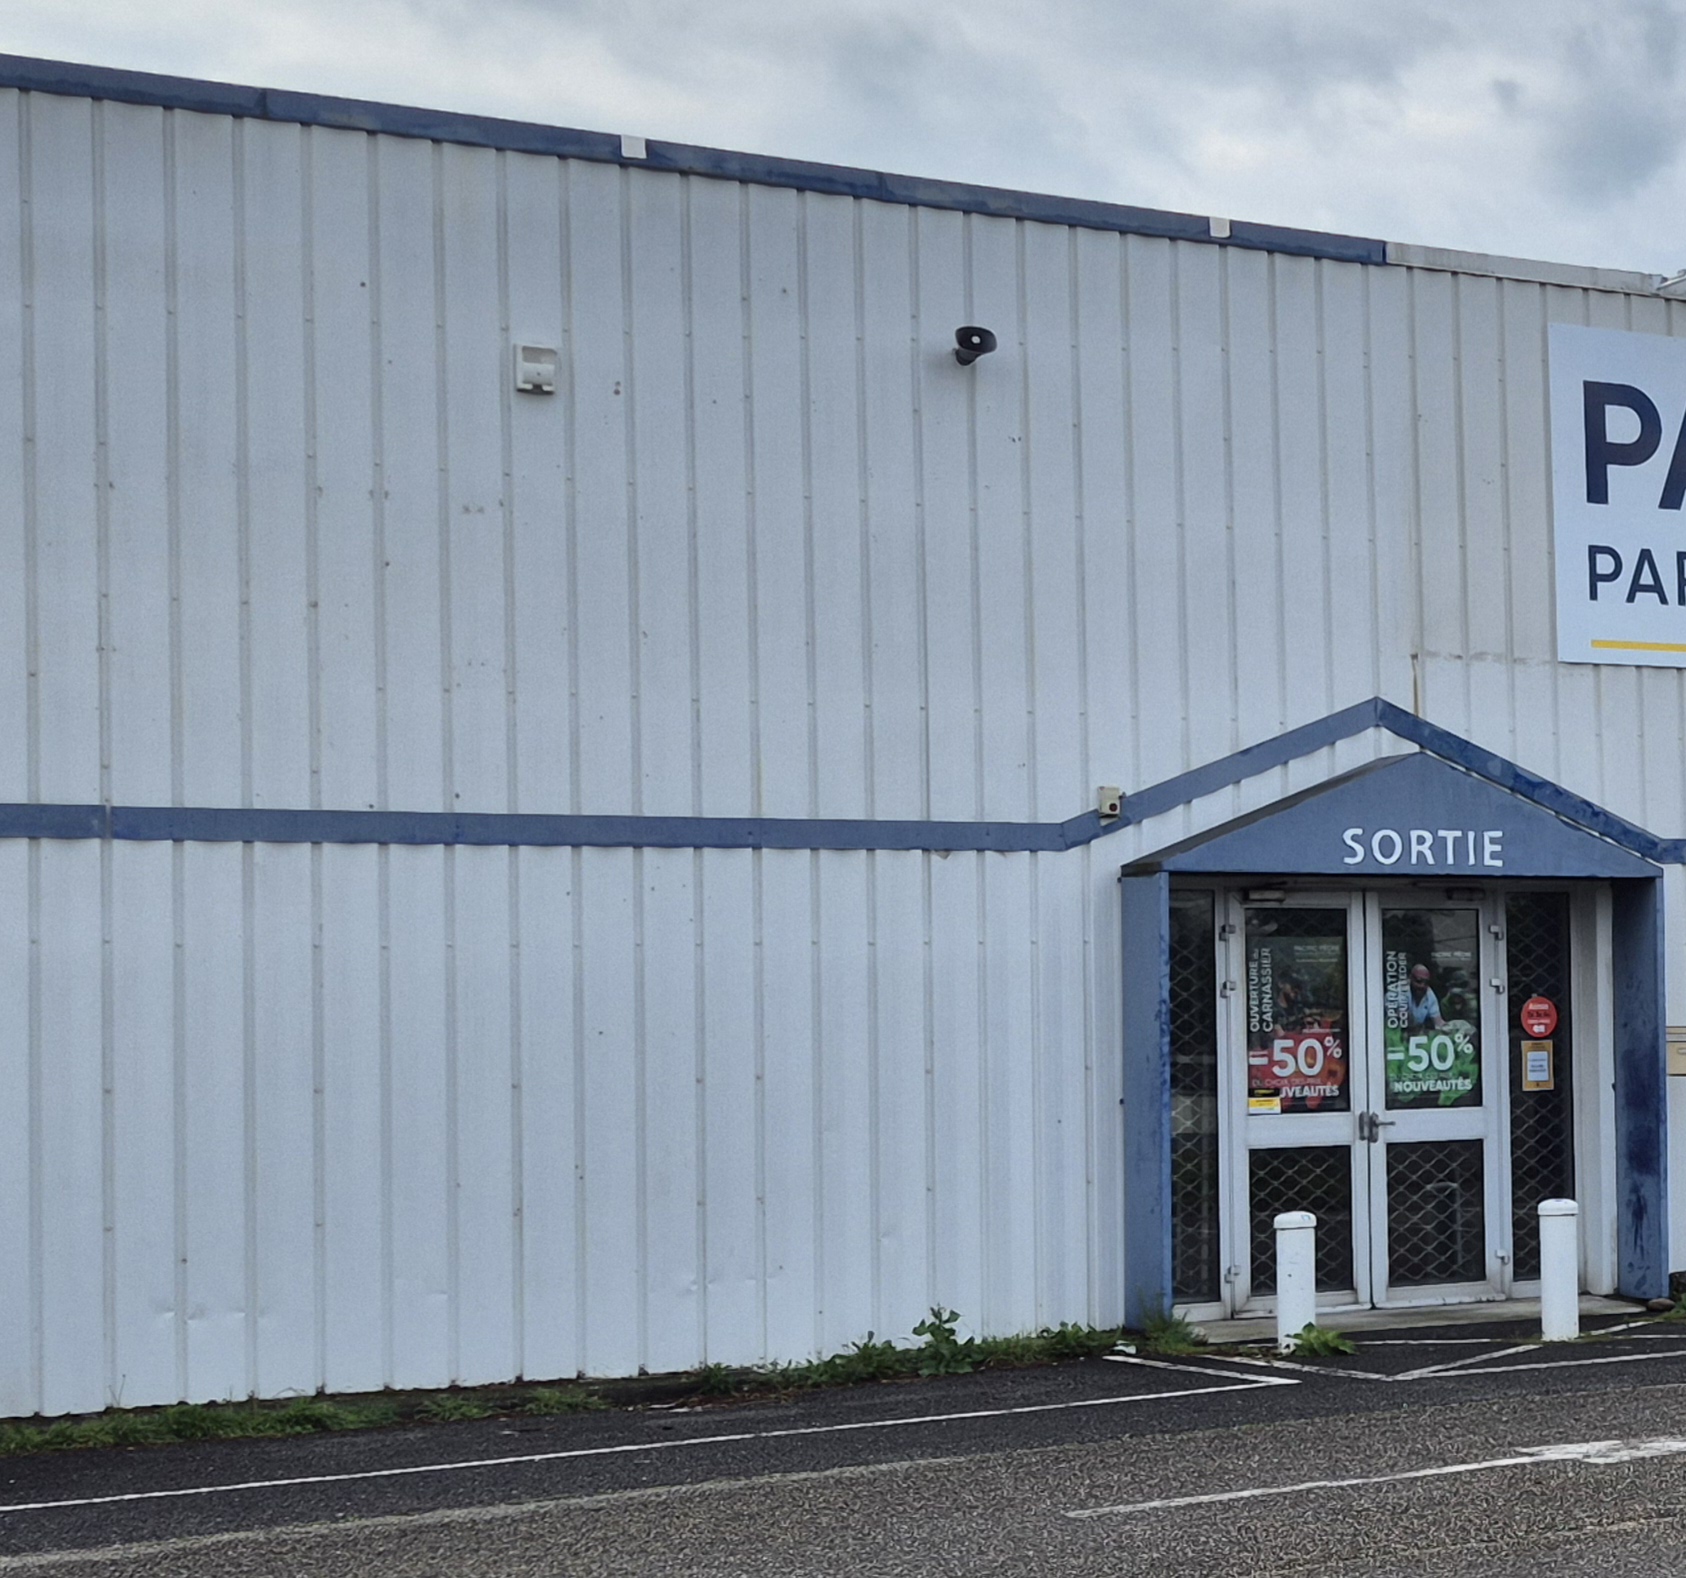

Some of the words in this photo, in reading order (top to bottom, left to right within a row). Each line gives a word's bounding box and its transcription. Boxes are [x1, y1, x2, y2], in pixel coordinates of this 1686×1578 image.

[1342, 828, 1504, 867] SORTIE
[1249, 961, 1260, 1032] OUVERTURE
[1261, 948, 1273, 1032] CARNASSIER
[1249, 1036, 1342, 1077] -50%
[1387, 1034, 1474, 1072] -50%
[1394, 1077, 1472, 1092] NOUVEAUTÉS
